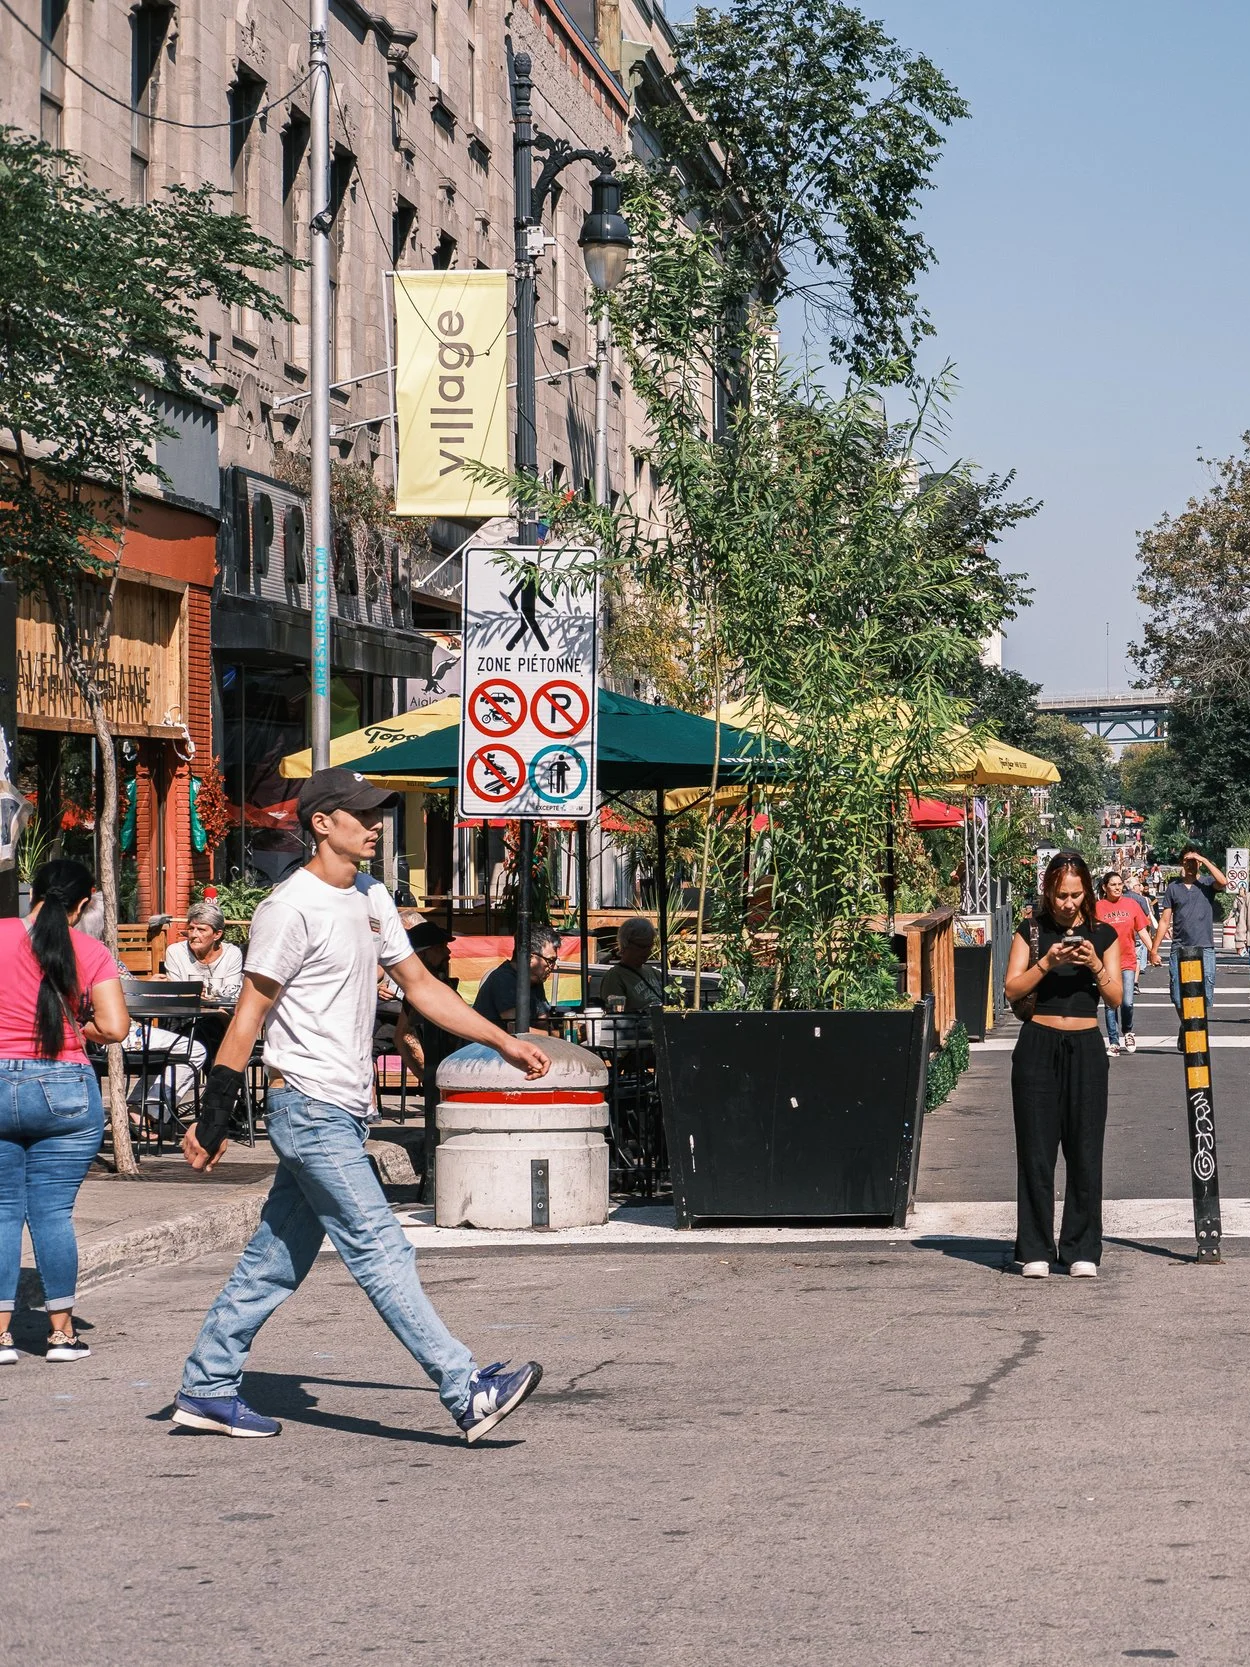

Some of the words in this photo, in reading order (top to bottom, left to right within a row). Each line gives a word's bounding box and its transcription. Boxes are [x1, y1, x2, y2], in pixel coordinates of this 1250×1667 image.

[430, 310, 475, 477] village
[477, 657, 511, 672] ZONE
[518, 654, 582, 673] PIÉTONNE
[1104, 910, 1129, 919] CANADA
